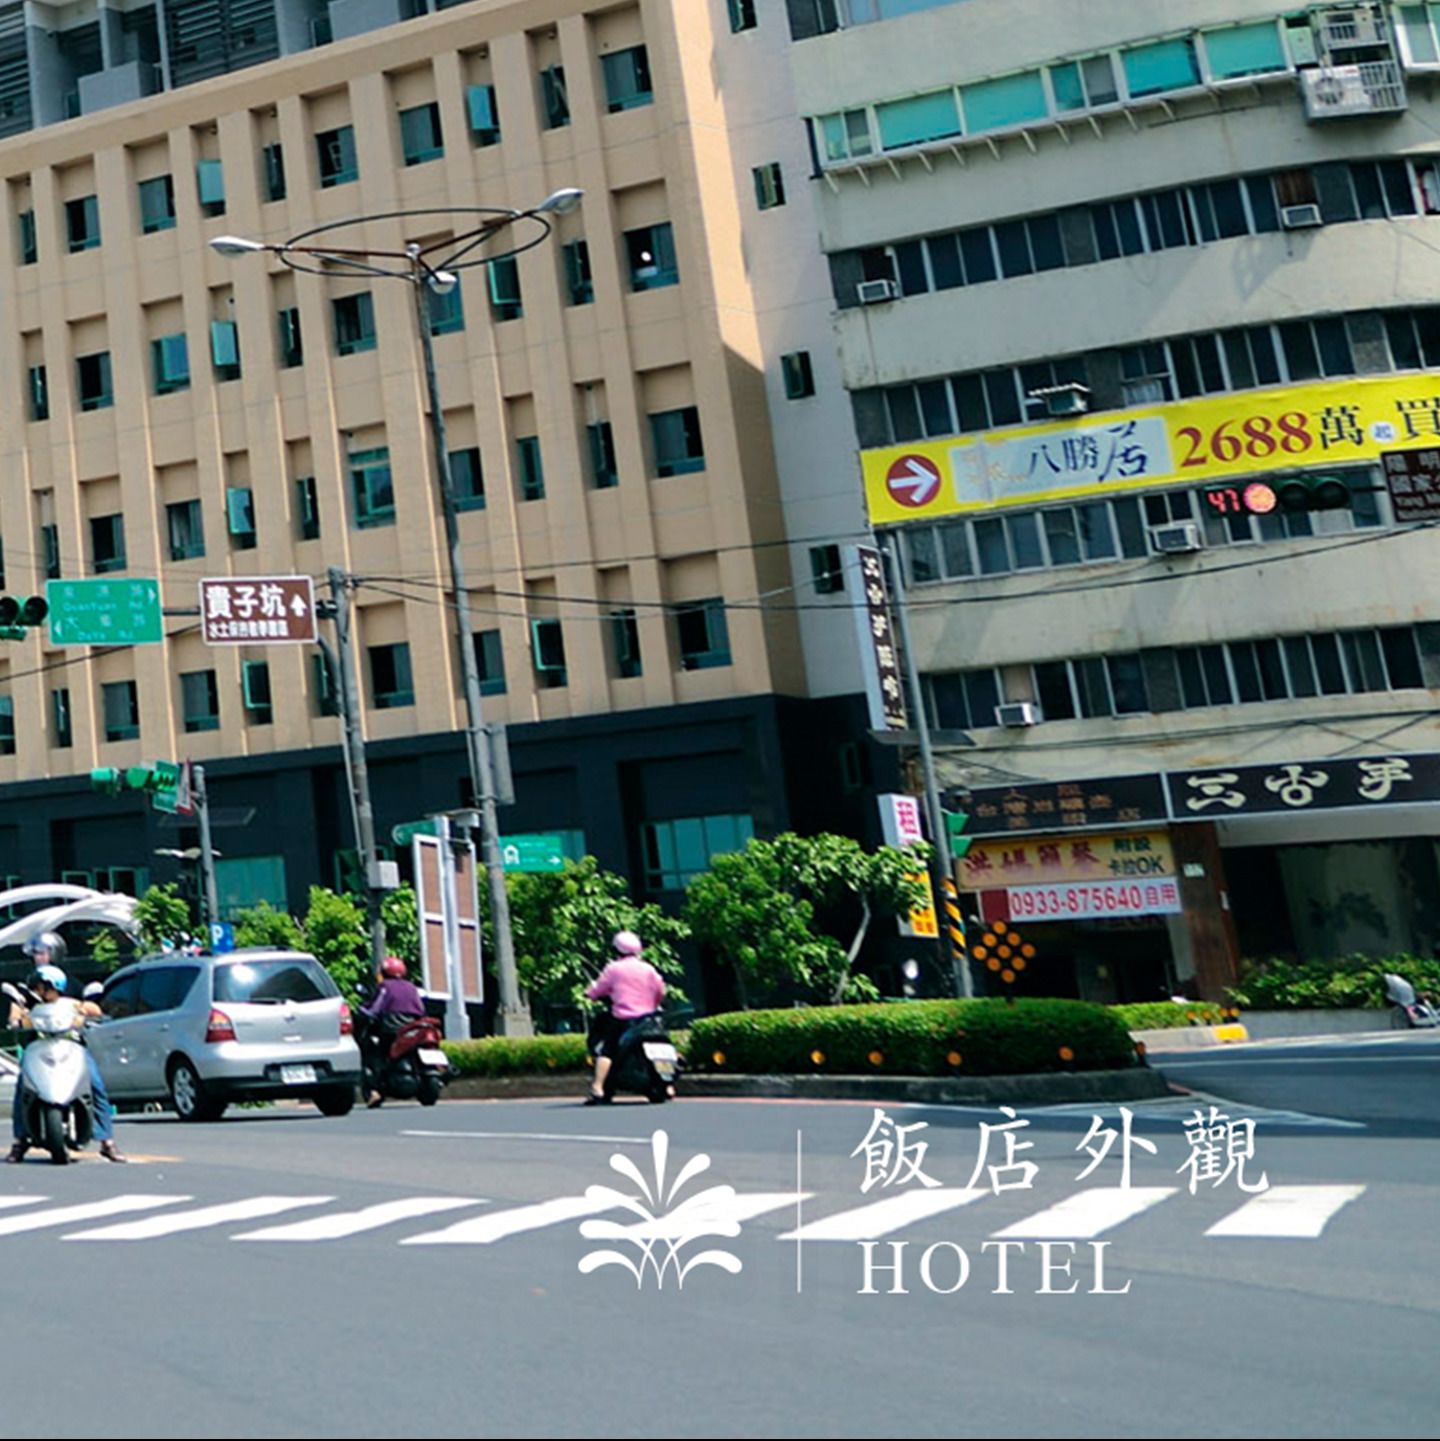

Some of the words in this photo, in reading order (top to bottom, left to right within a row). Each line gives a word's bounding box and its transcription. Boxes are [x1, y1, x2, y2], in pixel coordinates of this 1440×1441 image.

[206, 583, 287, 619] 貴子坑
[1012, 885, 1142, 915] 0933-875640
